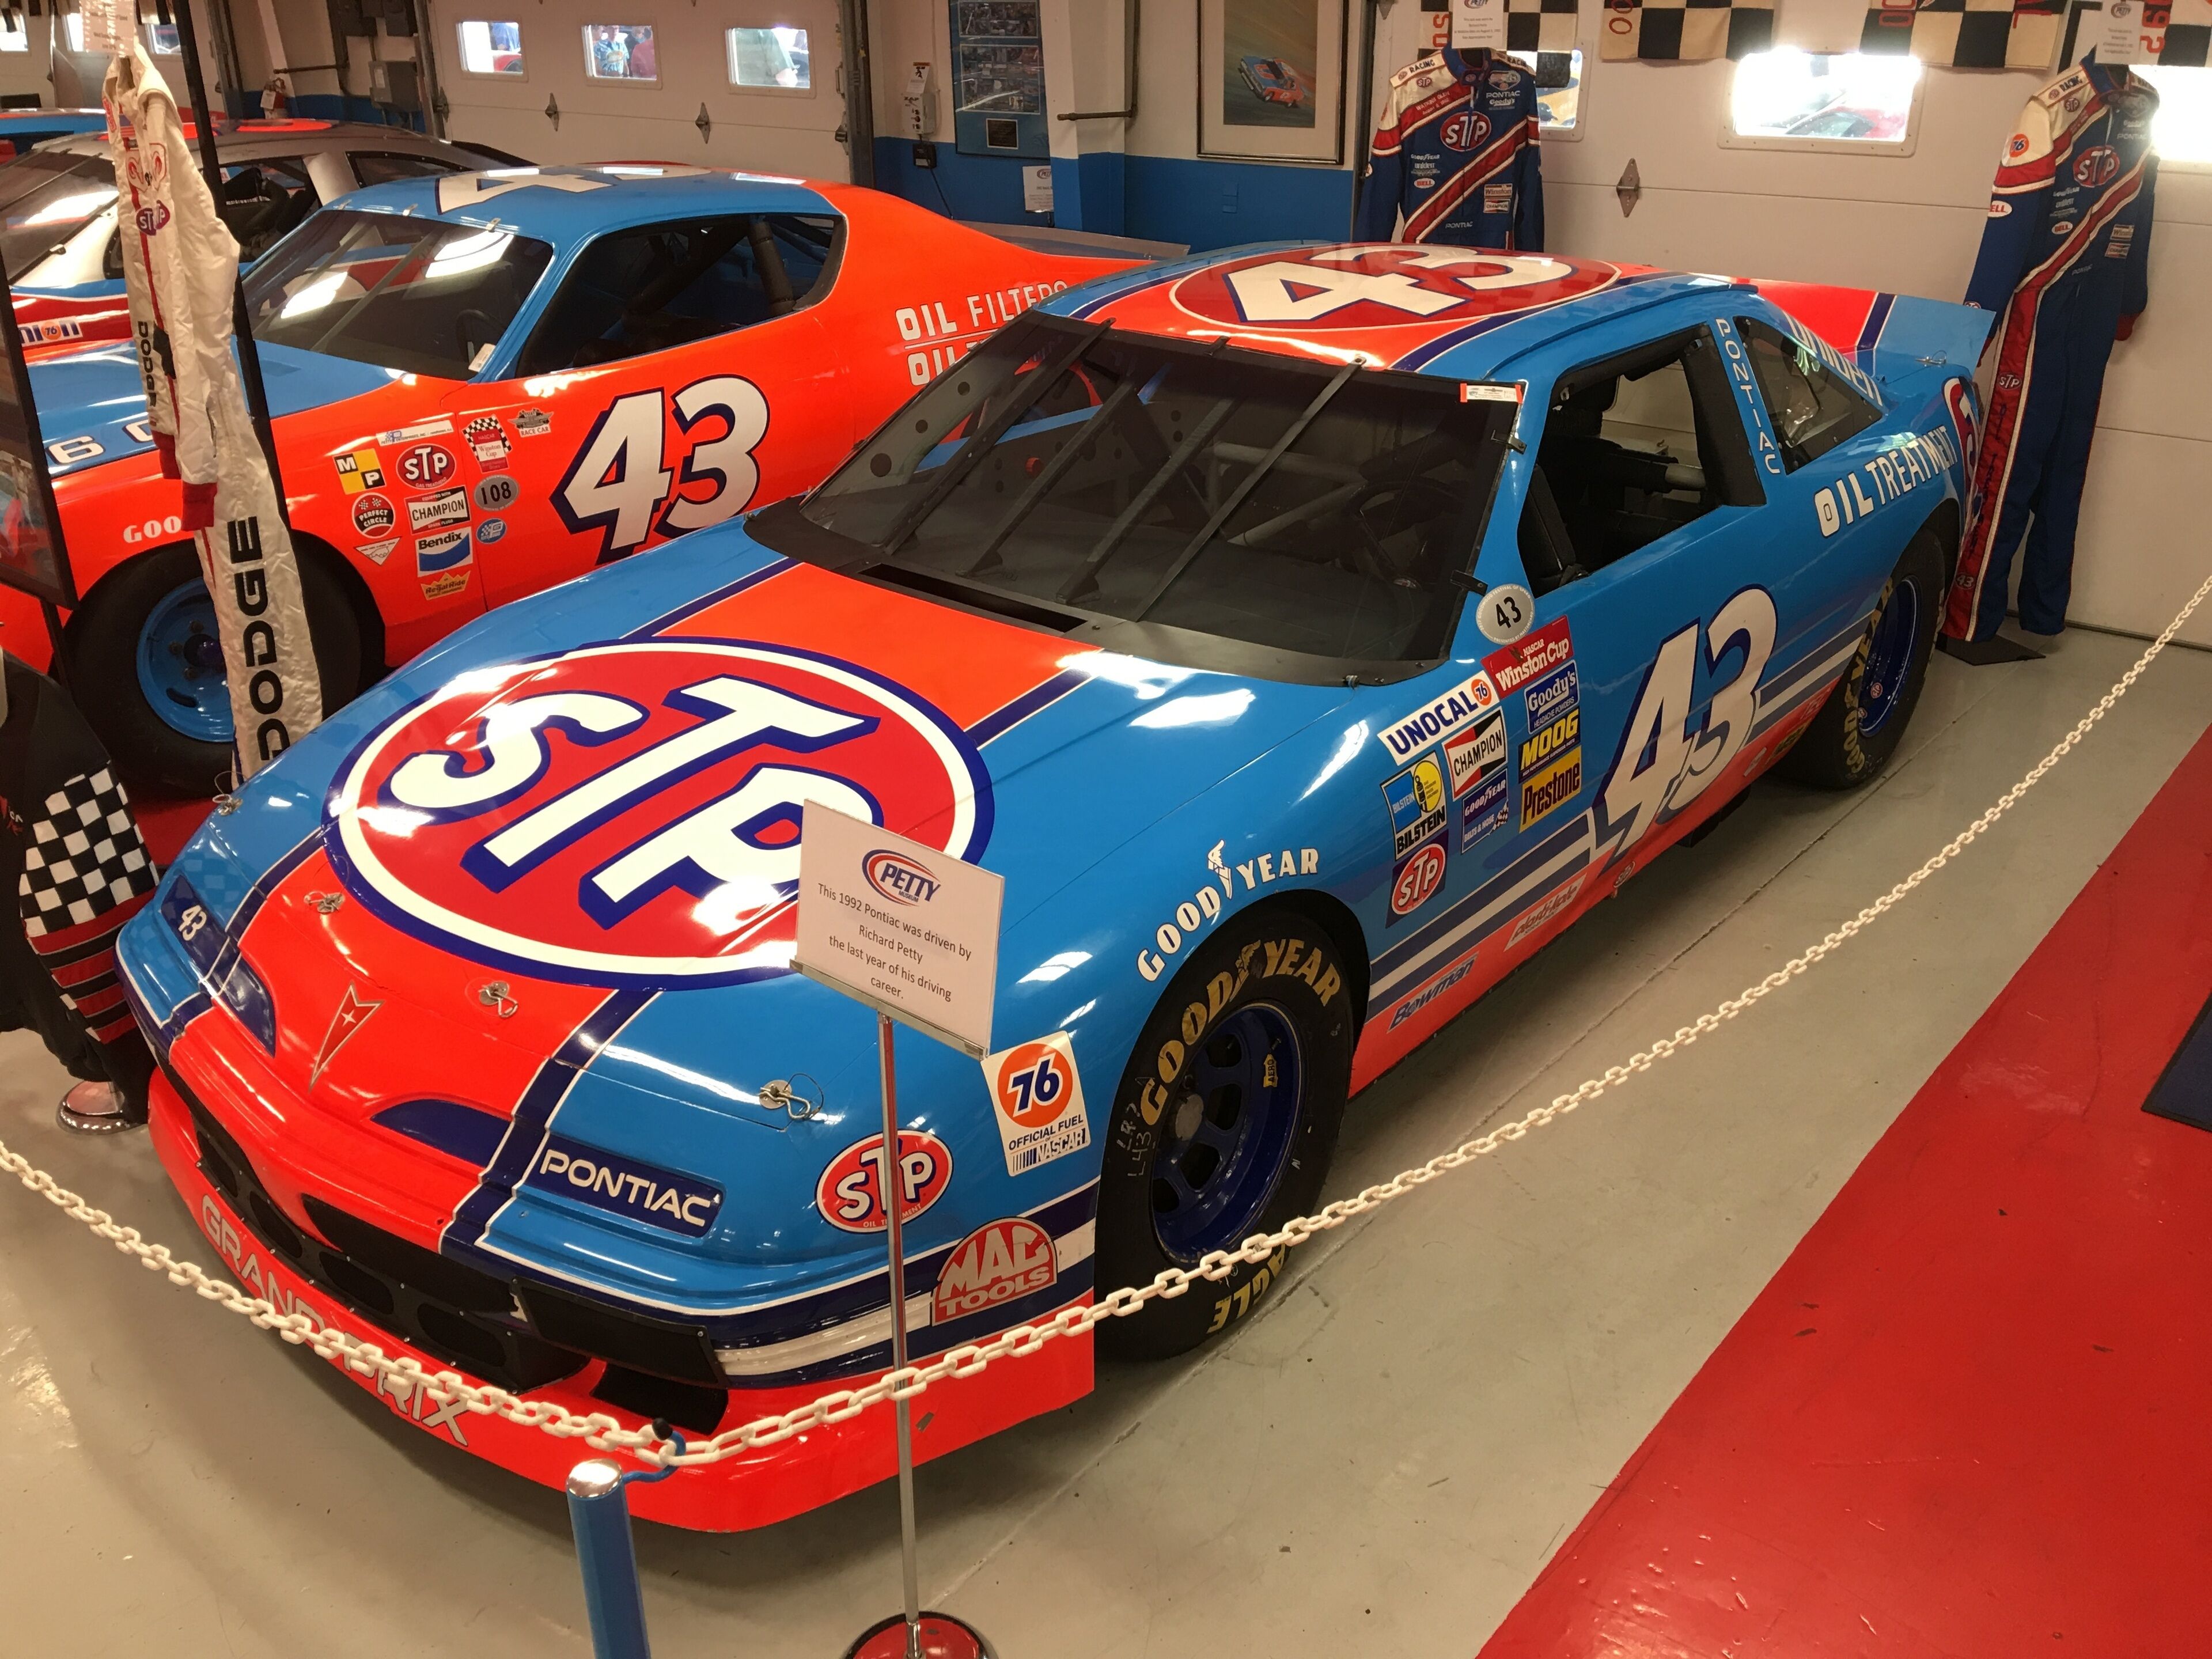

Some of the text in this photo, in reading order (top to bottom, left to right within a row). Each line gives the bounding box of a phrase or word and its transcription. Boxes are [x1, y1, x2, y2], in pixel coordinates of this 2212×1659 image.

[1409, 59, 1435, 73] RACING
[1417, 77, 1431, 86] STP
[2059, 75, 2083, 92] RACING
[2065, 98, 2080, 112] STP
[1446, 116, 1488, 146] STP
[2012, 140, 2025, 151] 76
[2078, 150, 2115, 183] STP
[139, 207, 166, 231] STP
[1227, 243, 1579, 322] 43
[895, 301, 958, 342] OIL
[1715, 318, 1781, 475] PONTIAC
[1999, 374, 2020, 388] STP
[478, 444, 501, 452] Winston
[521, 428, 536, 436] RACE
[336, 457, 357, 472] M
[365, 471, 380, 486] P
[404, 446, 448, 480] STP
[550, 374, 770, 565] 43
[412, 499, 464, 521] CHAMPION
[480, 481, 512, 505] 108
[1813, 471, 1874, 537] OIL
[358, 509, 388, 521] PERFECT
[363, 517, 388, 528] CIRCLE
[418, 532, 463, 551] Bendix
[449, 578, 466, 588] Ride
[1957, 576, 1975, 588] 43
[1496, 596, 1522, 628] 43
[1495, 637, 1570, 691] Winston Cup
[1522, 638, 1545, 656] NASCAR
[1474, 681, 1488, 700] 76
[1528, 671, 1576, 715] Goody's
[1386, 690, 1479, 756] UNOCAL
[1533, 696, 1575, 729] HEADACHE POWDERS
[1593, 583, 1778, 871] 43
[1453, 729, 1503, 777] CHAMPION
[1520, 708, 1579, 771] MOOG
[380, 674, 884, 929] STP
[1392, 791, 1415, 814] BILSTEIN
[1465, 779, 1506, 817] GOODYEAR
[1522, 761, 1580, 825] Prestone
[1396, 805, 1445, 855] BILSTEIN
[880, 863, 941, 902] PETTY
[1398, 850, 1438, 907] STP
[898, 890, 919, 903] MUSEUM
[178, 904, 208, 942] 43
[818, 882, 972, 961] This 1992 Pontiac was driven by
[1137, 847, 1319, 982] GOODYEAR
[859, 924, 923, 965] Richard Petty
[829, 935, 952, 1003] the last year of his driving
[870, 976, 904, 999] career.
[1389, 958, 1474, 1030] Bowman
[1140, 938, 1341, 1126] GOODYEAR
[1010, 1054, 1060, 1115] 76
[1267, 1059, 1275, 1084] AERO
[1009, 1114, 1084, 1151] OFFICIAL FUEL
[1036, 1128, 1086, 1162] NASCAR
[539, 1149, 712, 1228] PONTIAC
[836, 1139, 935, 1219] STP
[881, 1204, 922, 1226] TMENT
[202, 1194, 326, 1334] GRAND
[940, 1225, 1051, 1302] MAC
[938, 1266, 1051, 1317] TOOLS
